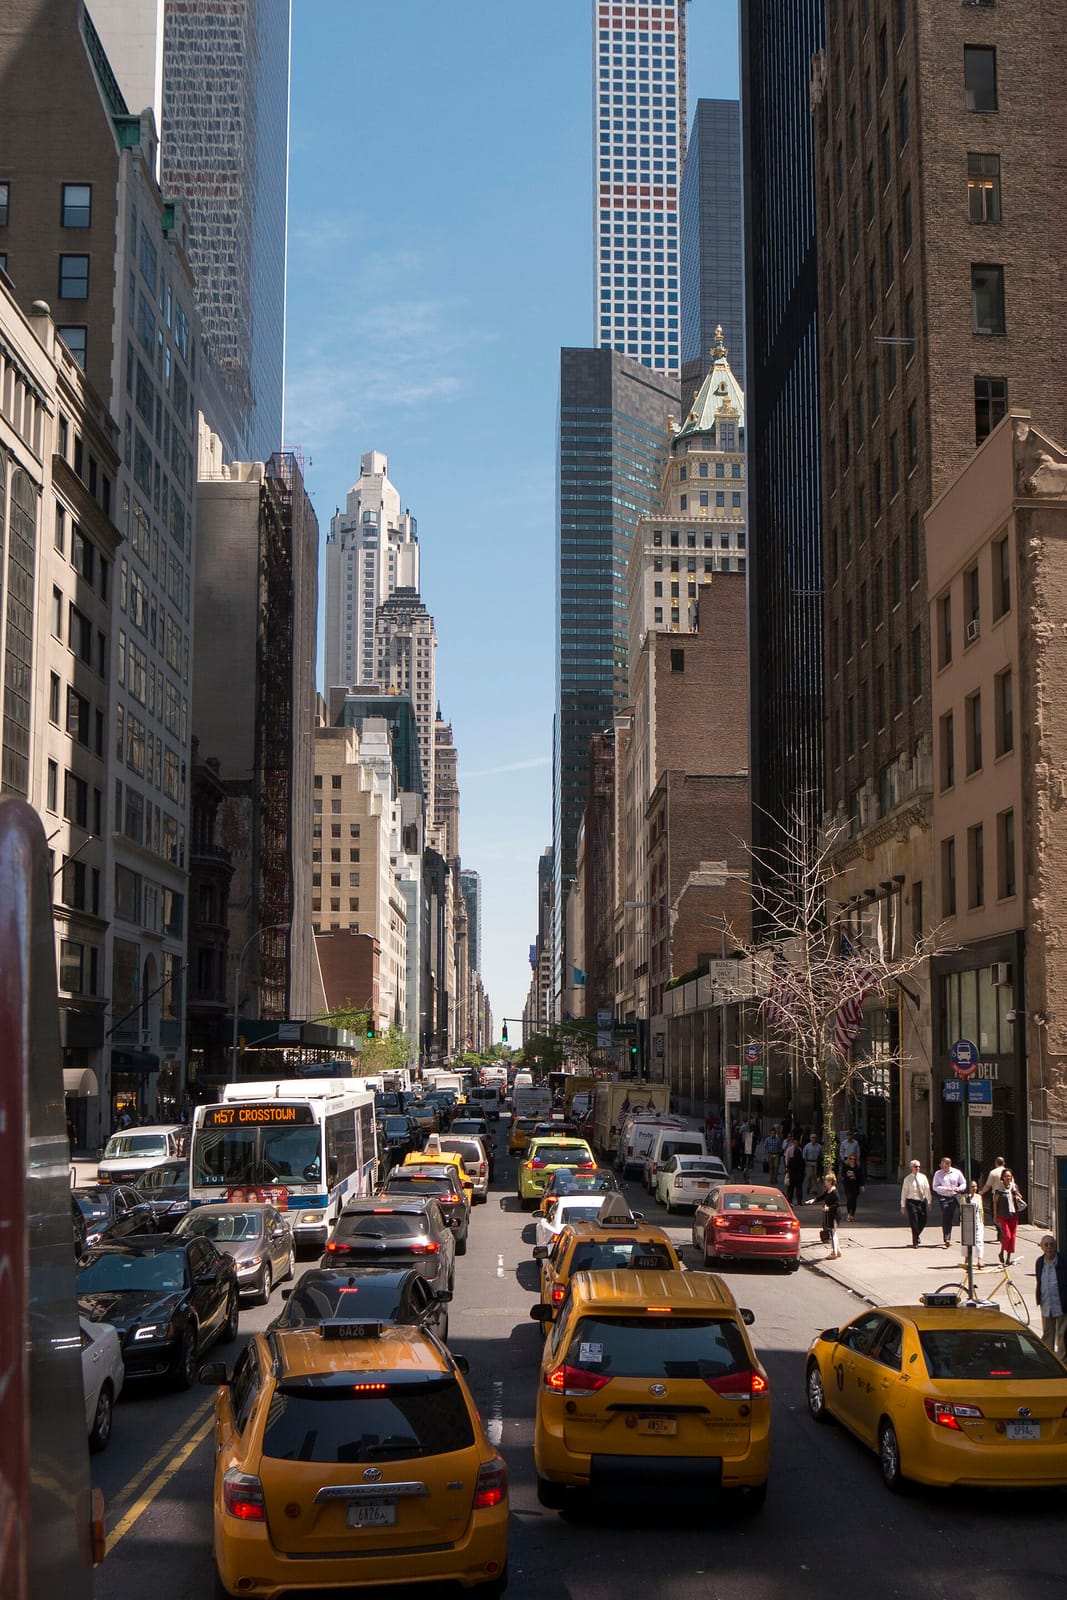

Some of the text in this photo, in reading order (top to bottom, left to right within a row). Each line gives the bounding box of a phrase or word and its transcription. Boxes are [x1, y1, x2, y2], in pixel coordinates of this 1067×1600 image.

[978, 1063, 999, 1080] DELI
[214, 1108, 296, 1123] M57 CROSSTOWN
[339, 1325, 365, 1336] 6A26
